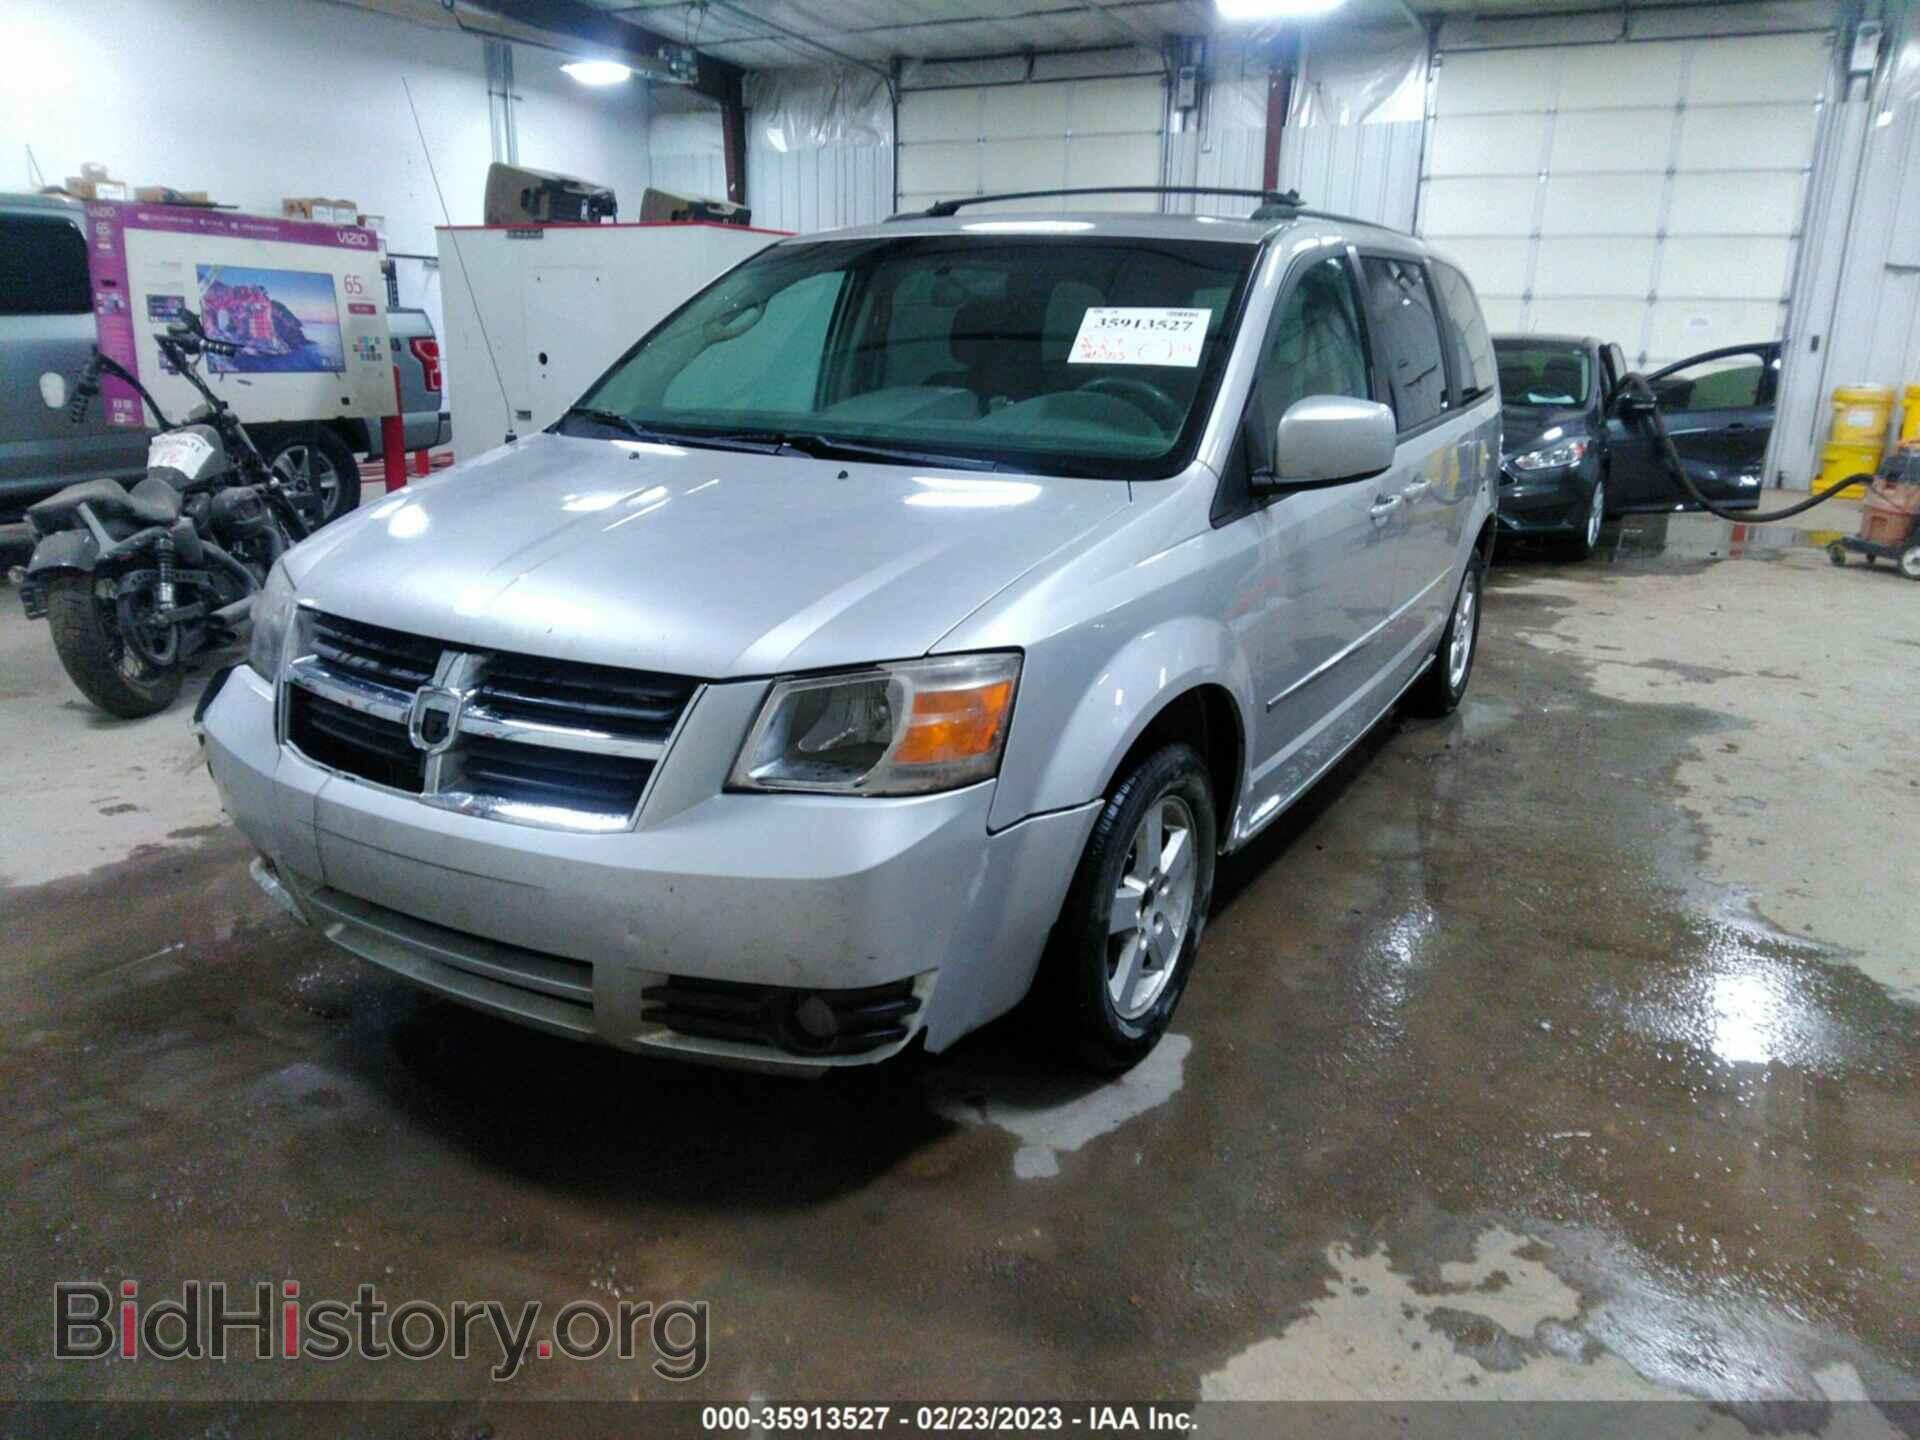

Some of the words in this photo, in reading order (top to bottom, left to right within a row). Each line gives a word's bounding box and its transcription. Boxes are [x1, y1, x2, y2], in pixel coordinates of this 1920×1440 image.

[336, 230, 369, 246] VIZIO
[343, 273, 363, 295] 65
[1094, 318, 1193, 331] 35913527
